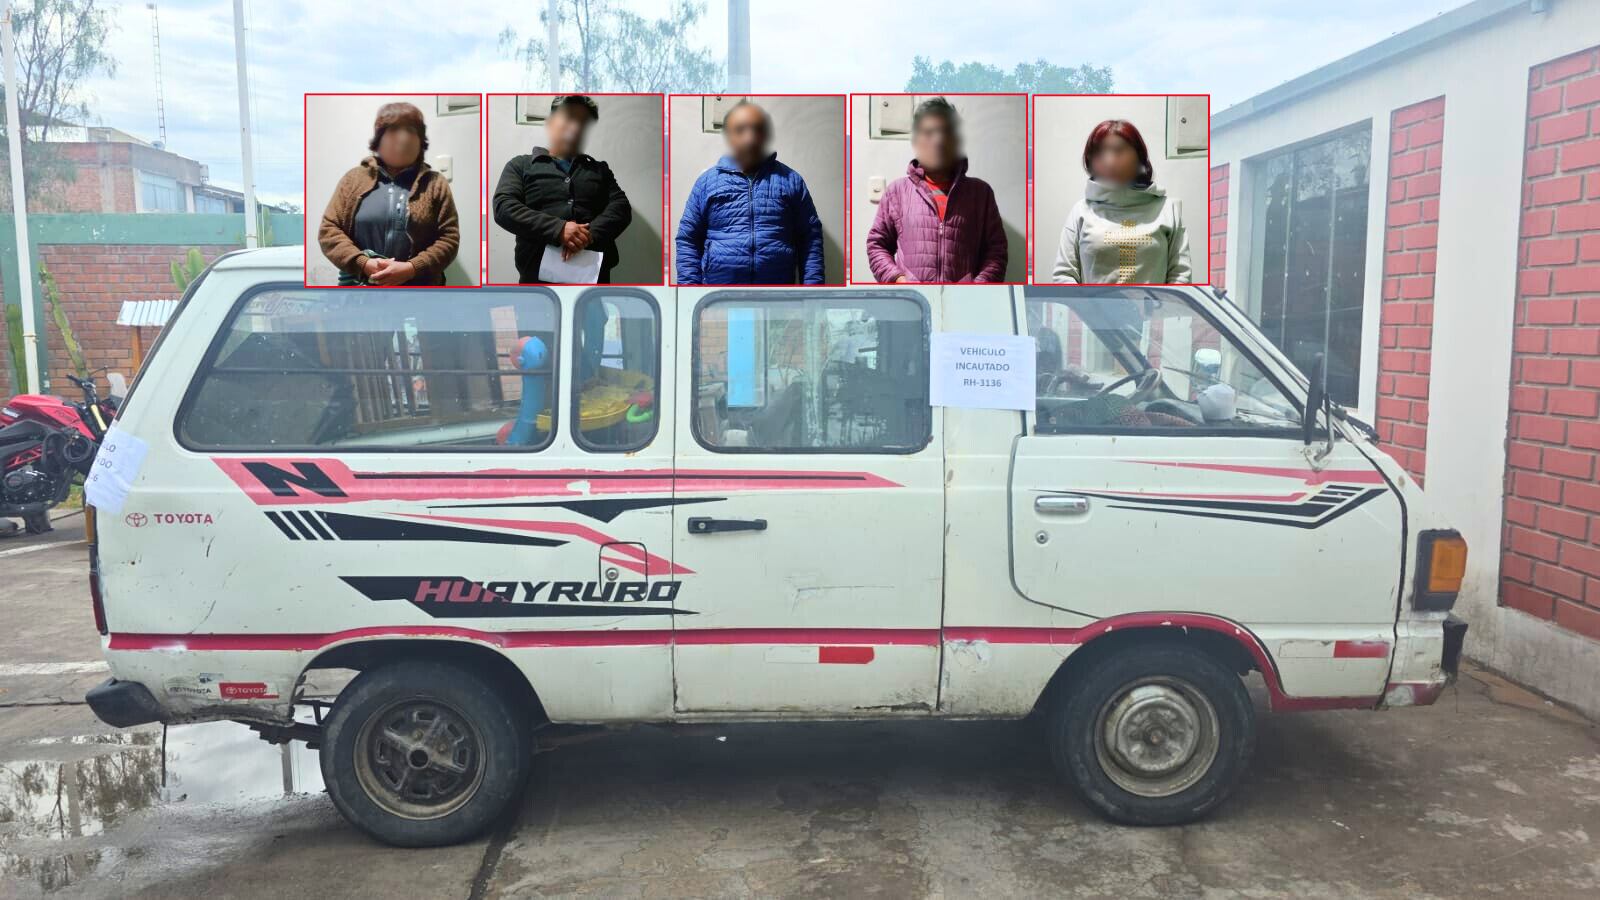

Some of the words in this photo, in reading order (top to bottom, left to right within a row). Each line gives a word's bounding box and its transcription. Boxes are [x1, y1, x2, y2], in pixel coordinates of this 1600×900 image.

[960, 347, 1006, 356] VEHICULO
[955, 362, 1010, 371] INCAUTADO
[963, 378, 1002, 387] RH-3136
[241, 462, 349, 497] N
[154, 513, 213, 524] TOYOTA
[414, 579, 682, 603] HUAYRURO
